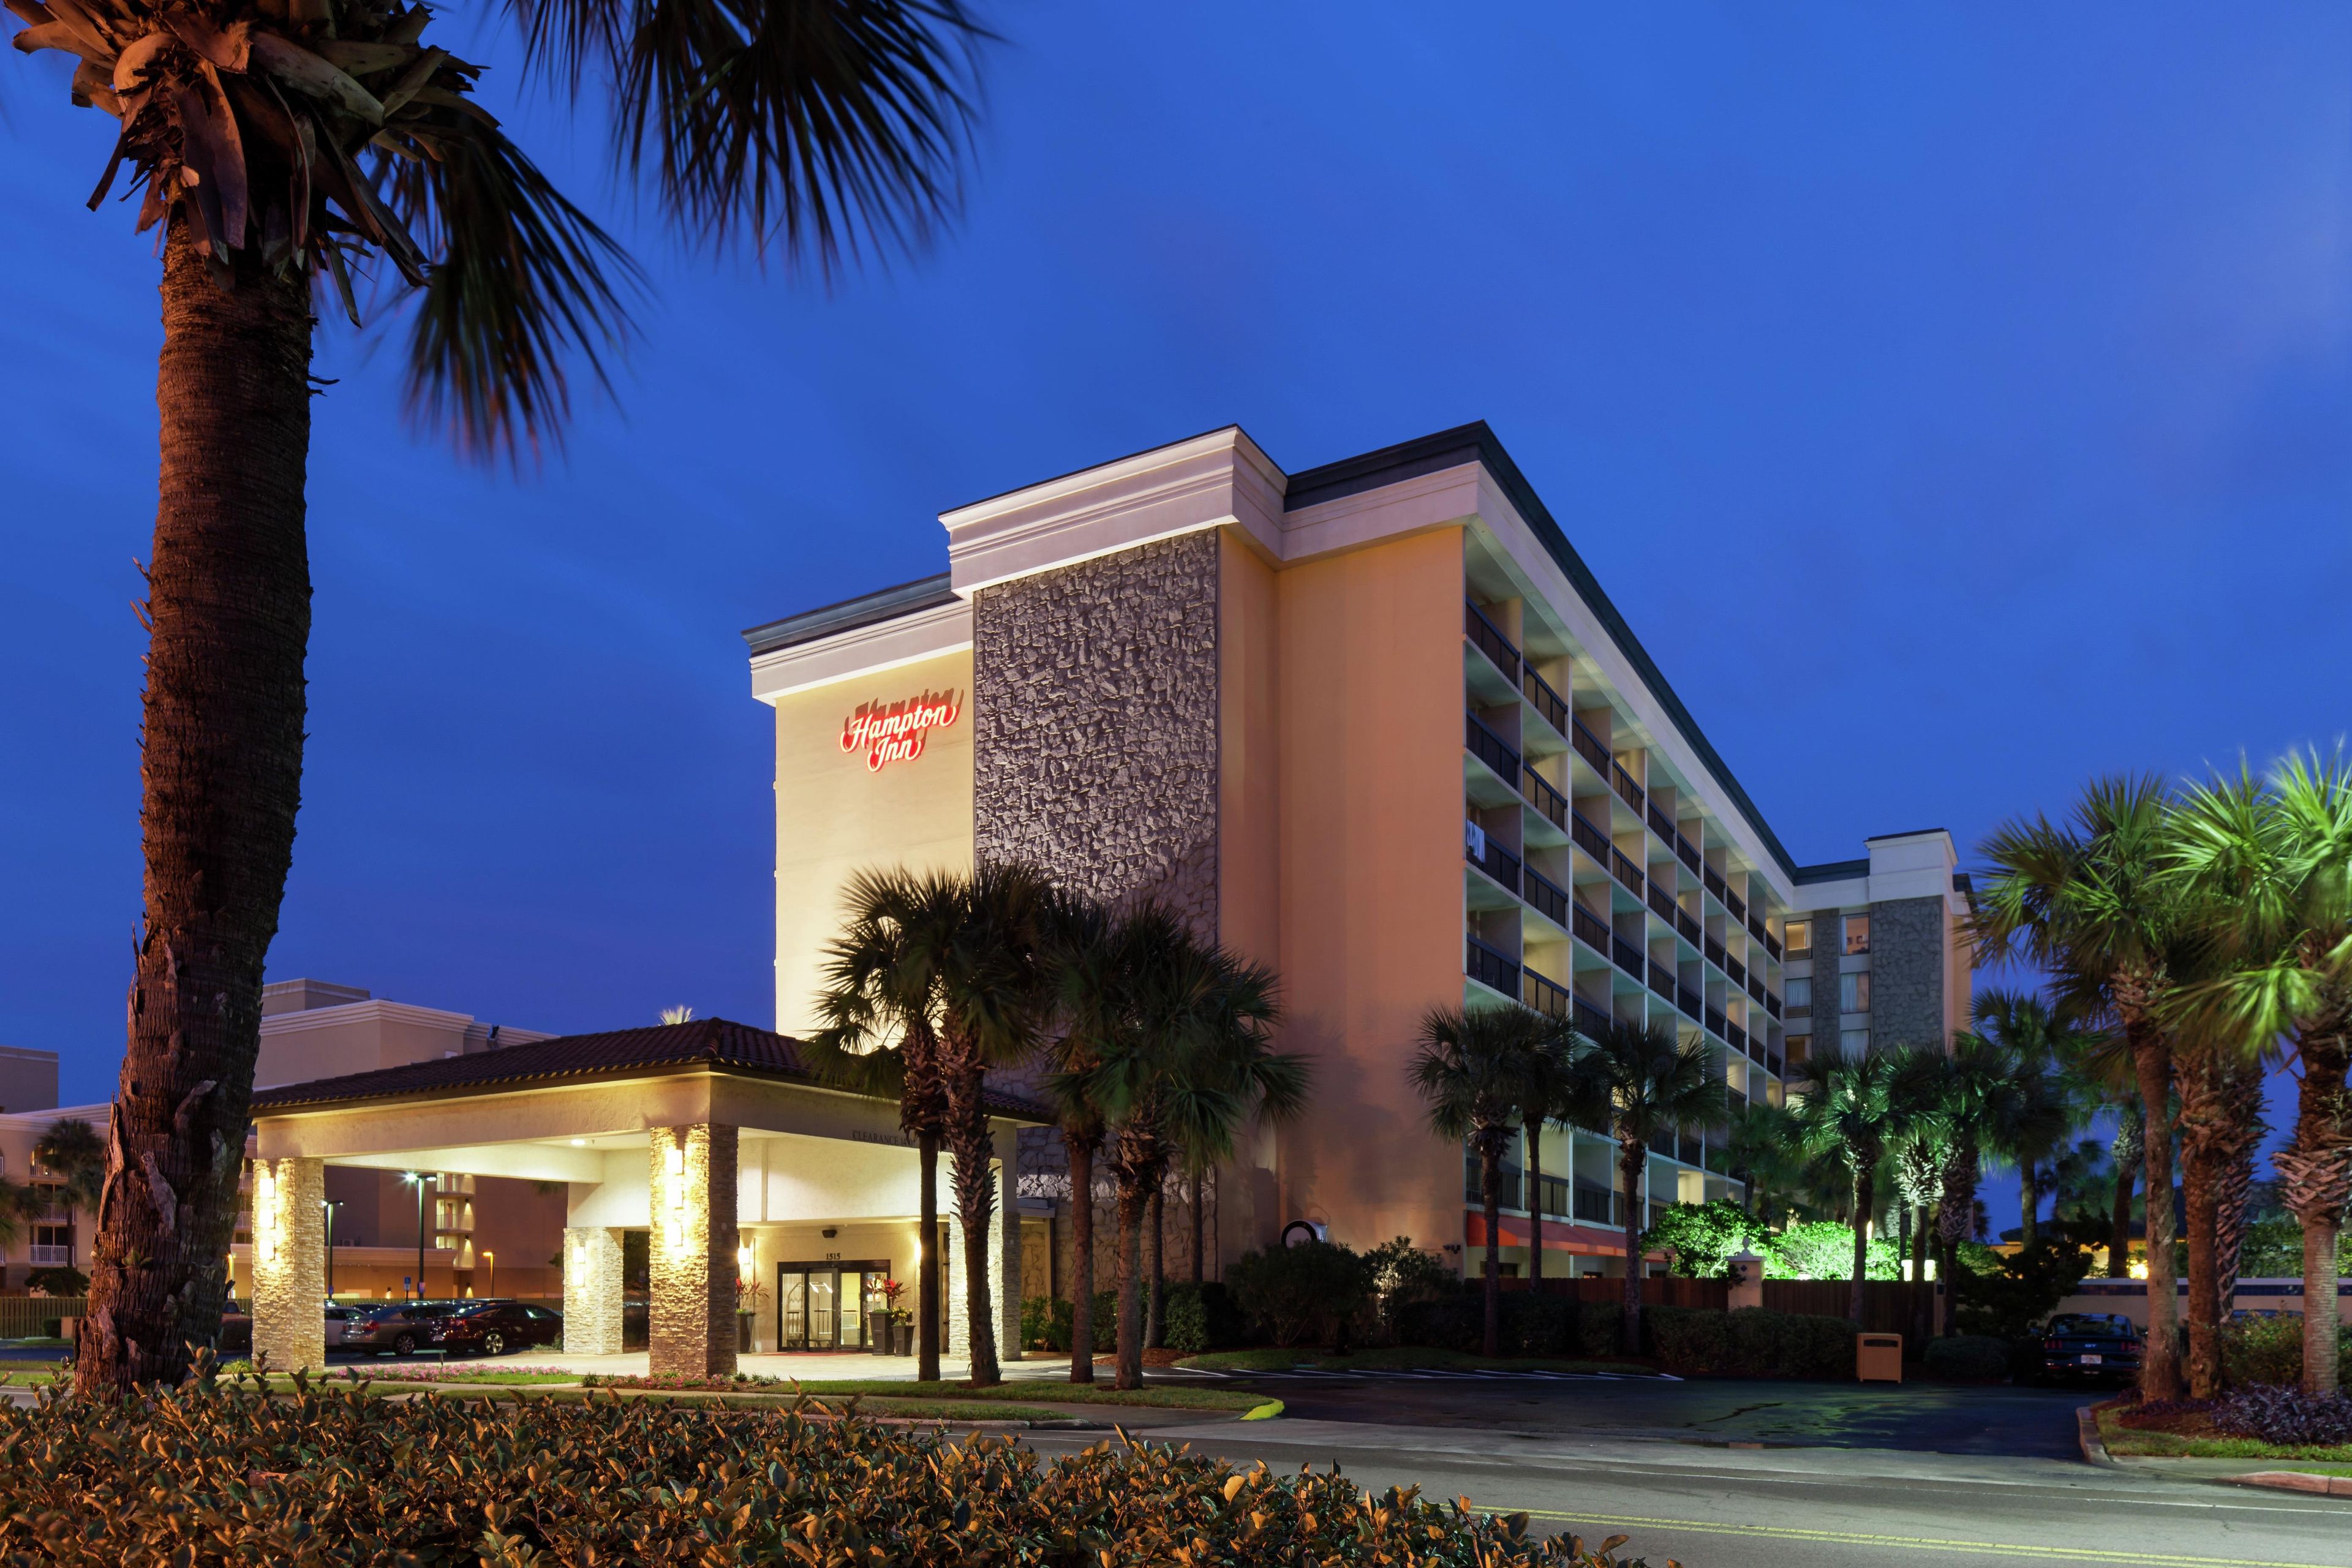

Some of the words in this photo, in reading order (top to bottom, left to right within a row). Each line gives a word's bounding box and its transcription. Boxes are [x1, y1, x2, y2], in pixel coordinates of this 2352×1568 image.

[840, 704, 957, 753] Hampton
[867, 736, 922, 772] Inn
[853, 1131, 899, 1145] CLEARANCE
